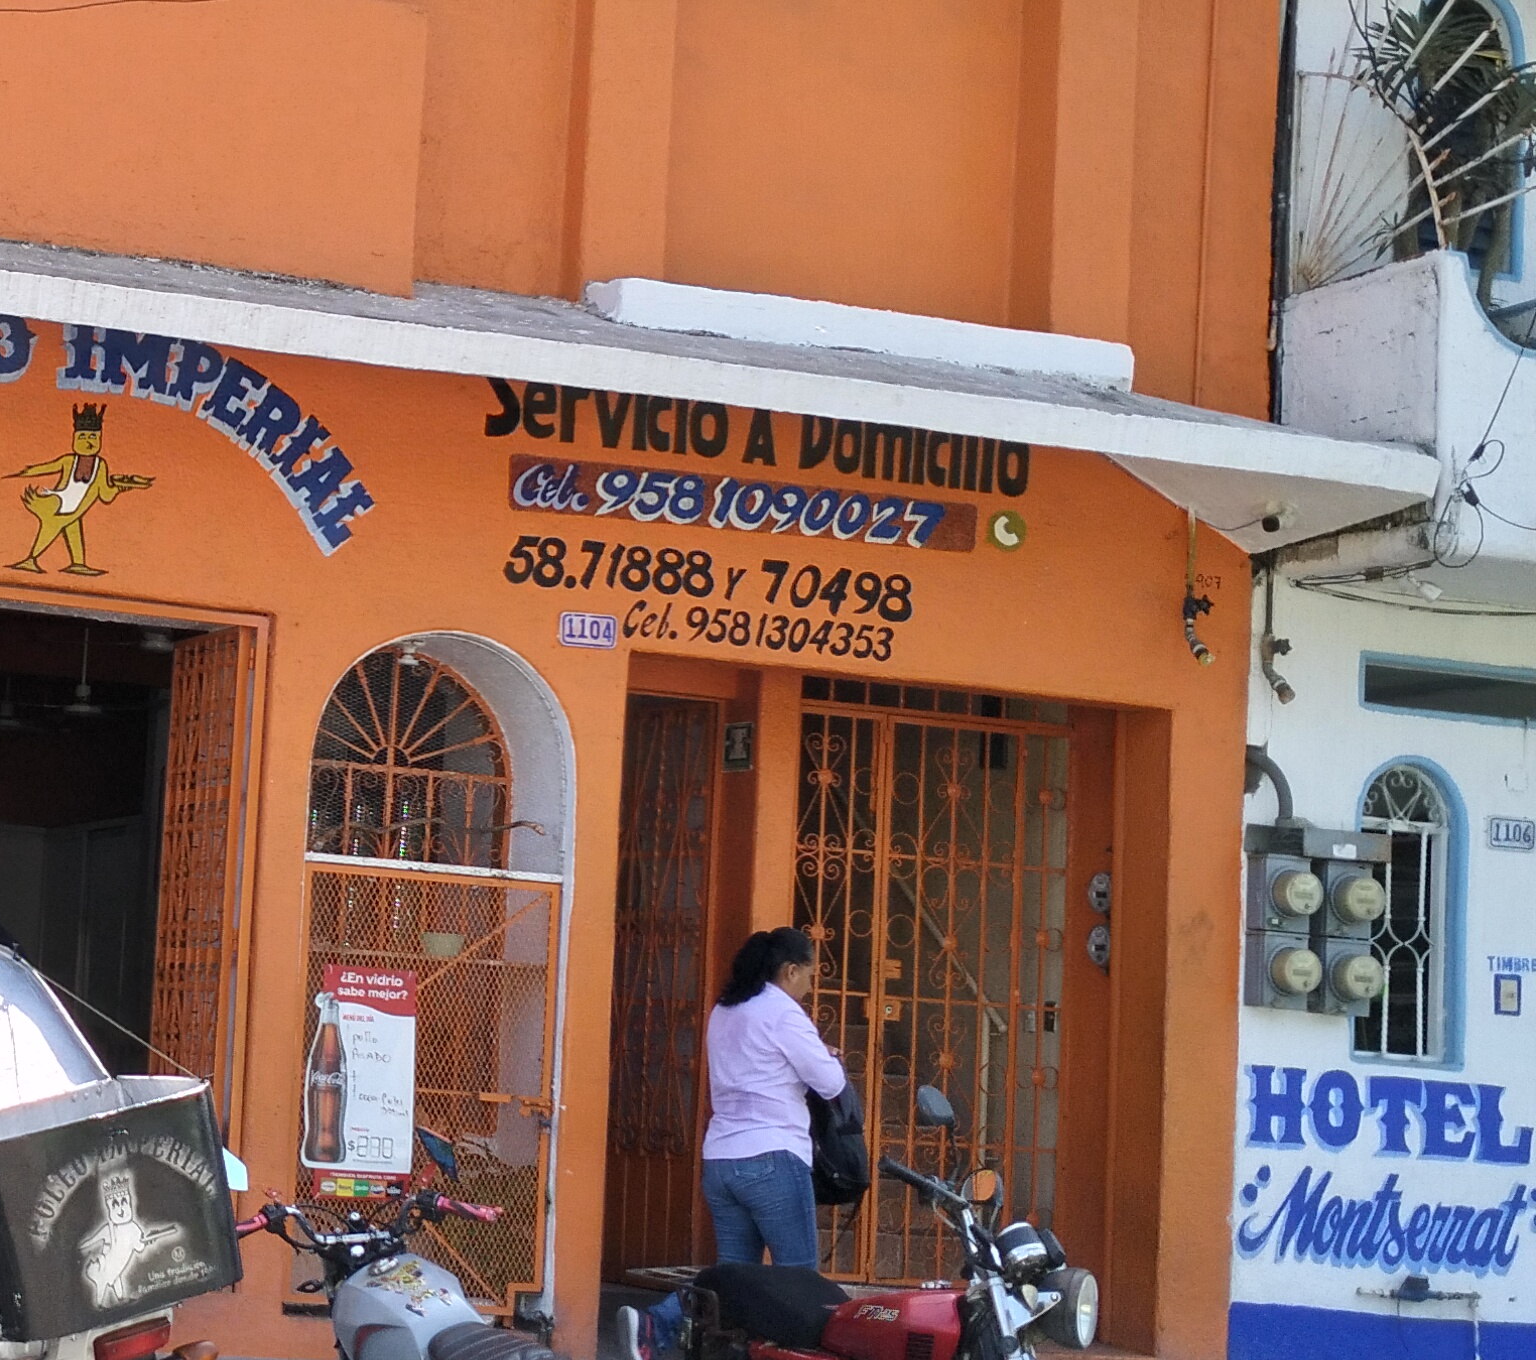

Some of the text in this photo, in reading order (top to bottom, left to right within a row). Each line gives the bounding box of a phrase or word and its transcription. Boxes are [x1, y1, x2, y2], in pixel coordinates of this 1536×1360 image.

[56, 323, 376, 557] IMPERIAL
[741, 409, 777, 468] A
[503, 535, 715, 601] 58.71888
[760, 559, 914, 623] 70498
[565, 617, 613, 643] 1104
[685, 610, 895, 662] 9581304353
[1492, 822, 1533, 845] 1106
[337, 986, 409, 1001] sabe mejor?
[340, 971, 404, 987] ¿En vidrio
[1243, 1064, 1534, 1167] HOTEL
